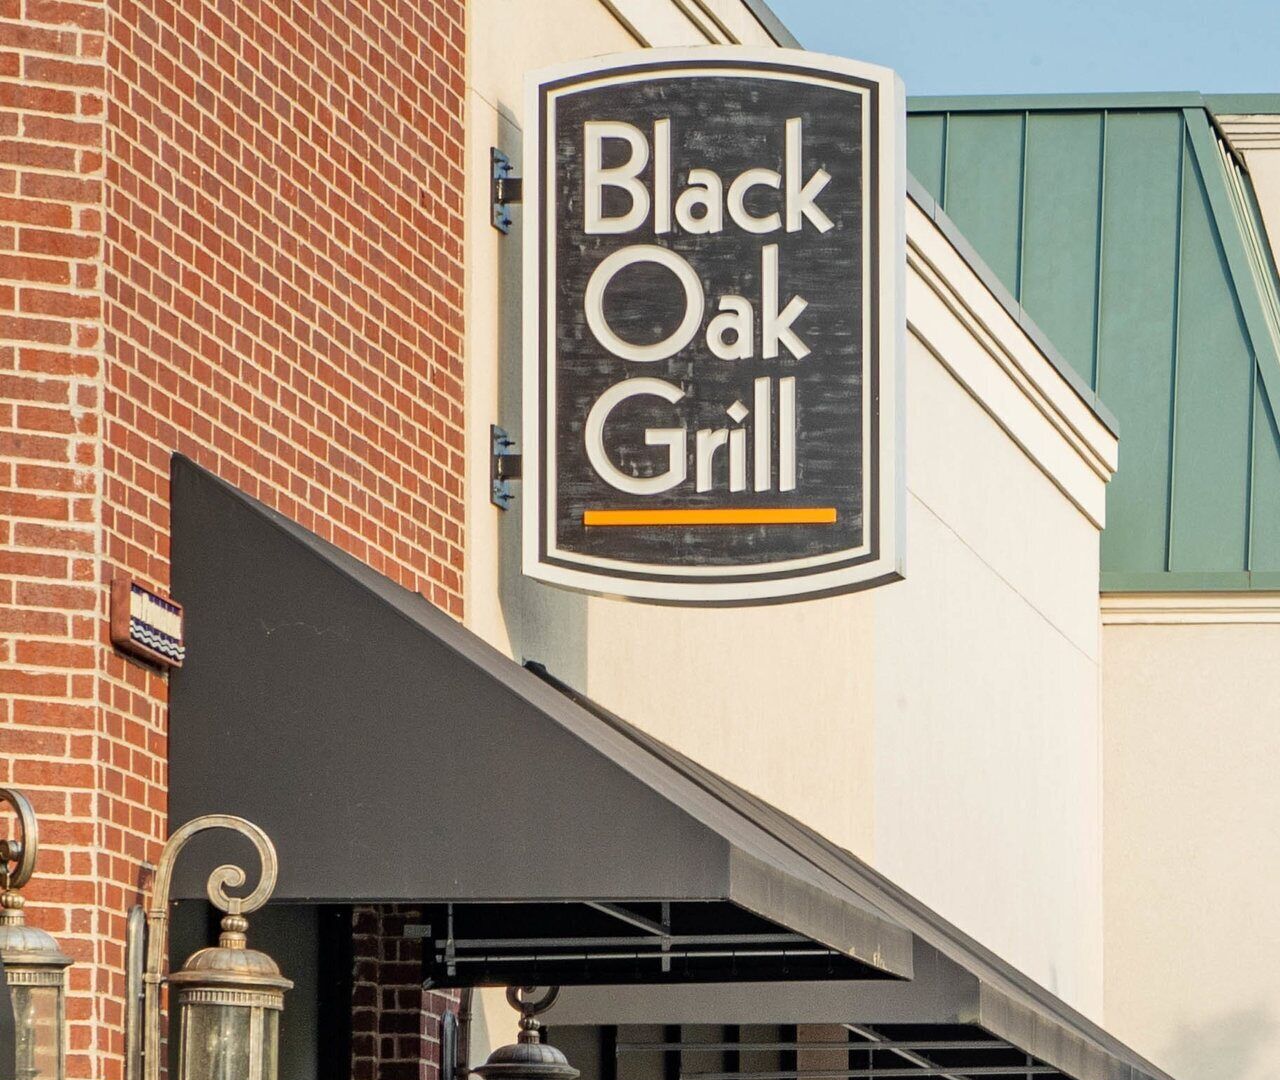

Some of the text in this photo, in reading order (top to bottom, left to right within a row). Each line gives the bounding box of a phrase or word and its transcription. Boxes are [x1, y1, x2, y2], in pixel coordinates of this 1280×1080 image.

[583, 117, 834, 235] Black
[583, 243, 812, 363] Oak
[583, 376, 797, 495] Grill
